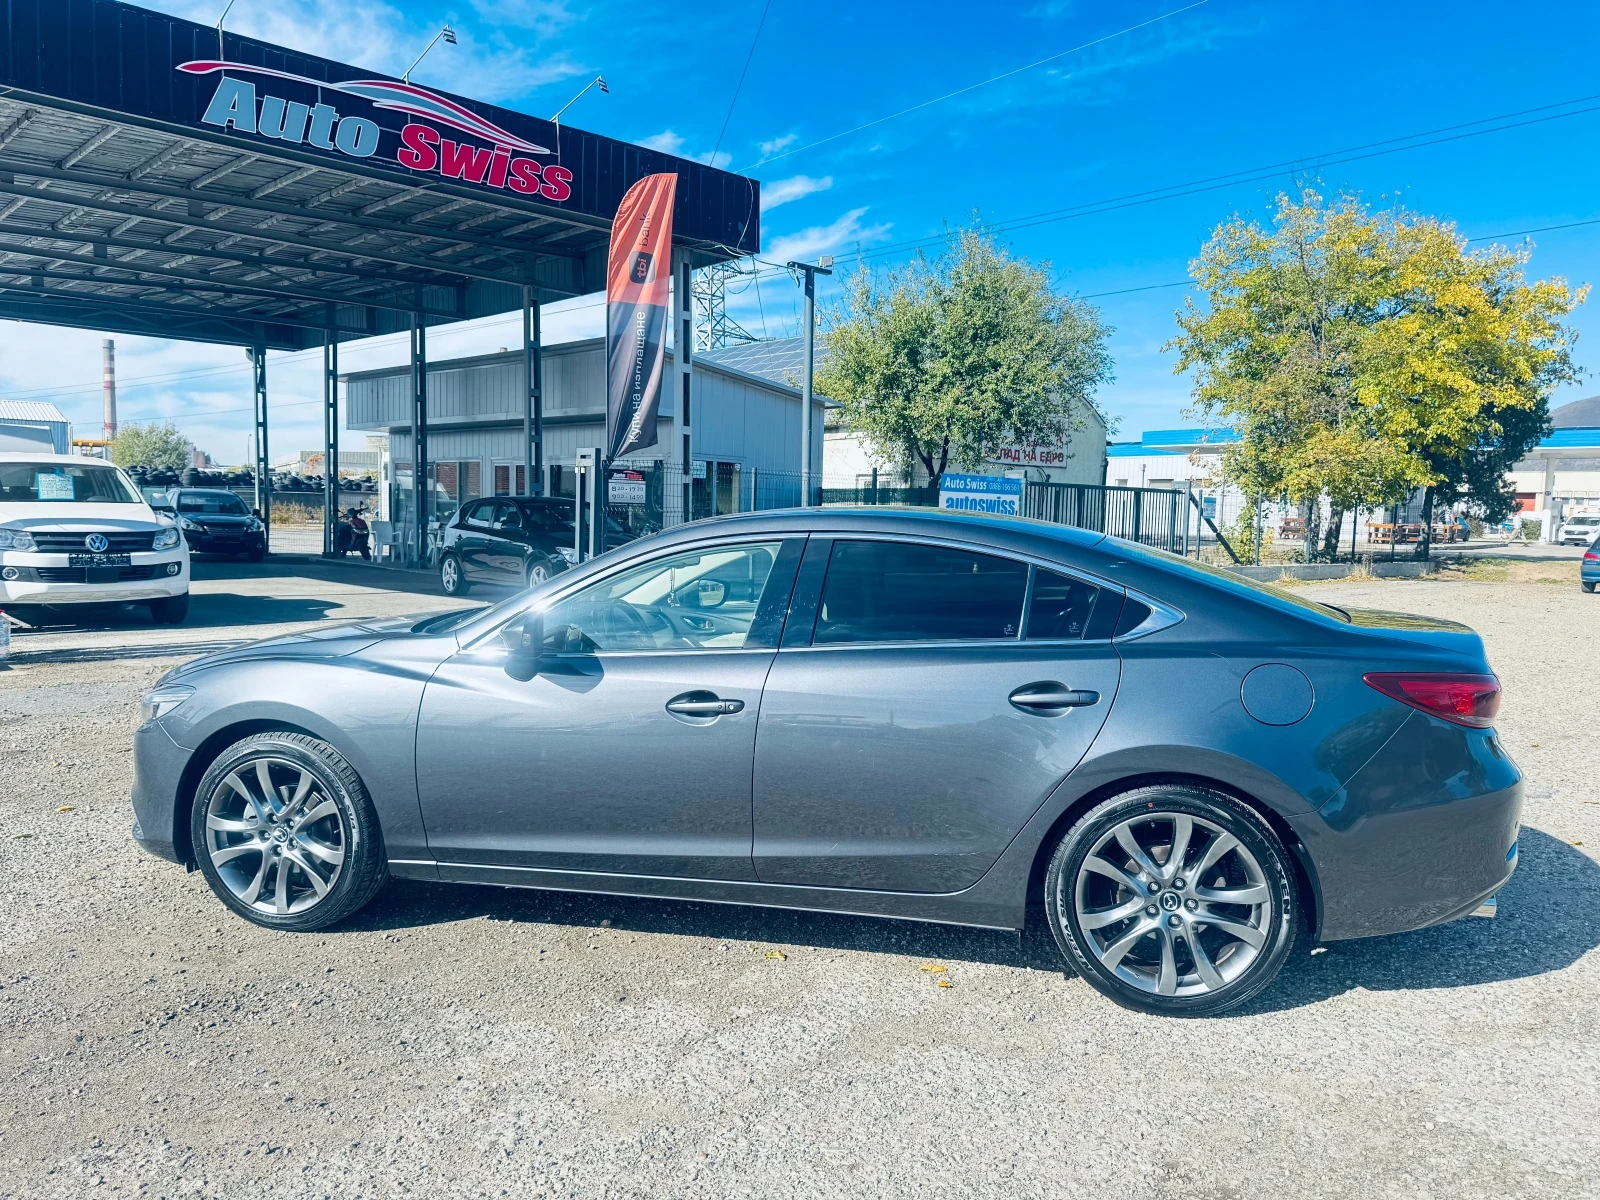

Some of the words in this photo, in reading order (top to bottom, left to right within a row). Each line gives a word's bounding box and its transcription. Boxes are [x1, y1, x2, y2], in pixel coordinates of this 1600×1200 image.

[201, 76, 380, 158] Auto
[397, 123, 573, 201] Swiss
[639, 212, 650, 246] bank
[638, 258, 647, 277] tbi
[635, 311, 645, 389] изплащане
[633, 393, 641, 410] на
[629, 412, 642, 443] Купи
[1024, 451, 1037, 461] НА
[944, 477, 965, 489] Auto
[966, 478, 987, 490] Swiss
[946, 496, 1016, 516] autoswiss
[1261, 836, 1290, 915] NEXEN
